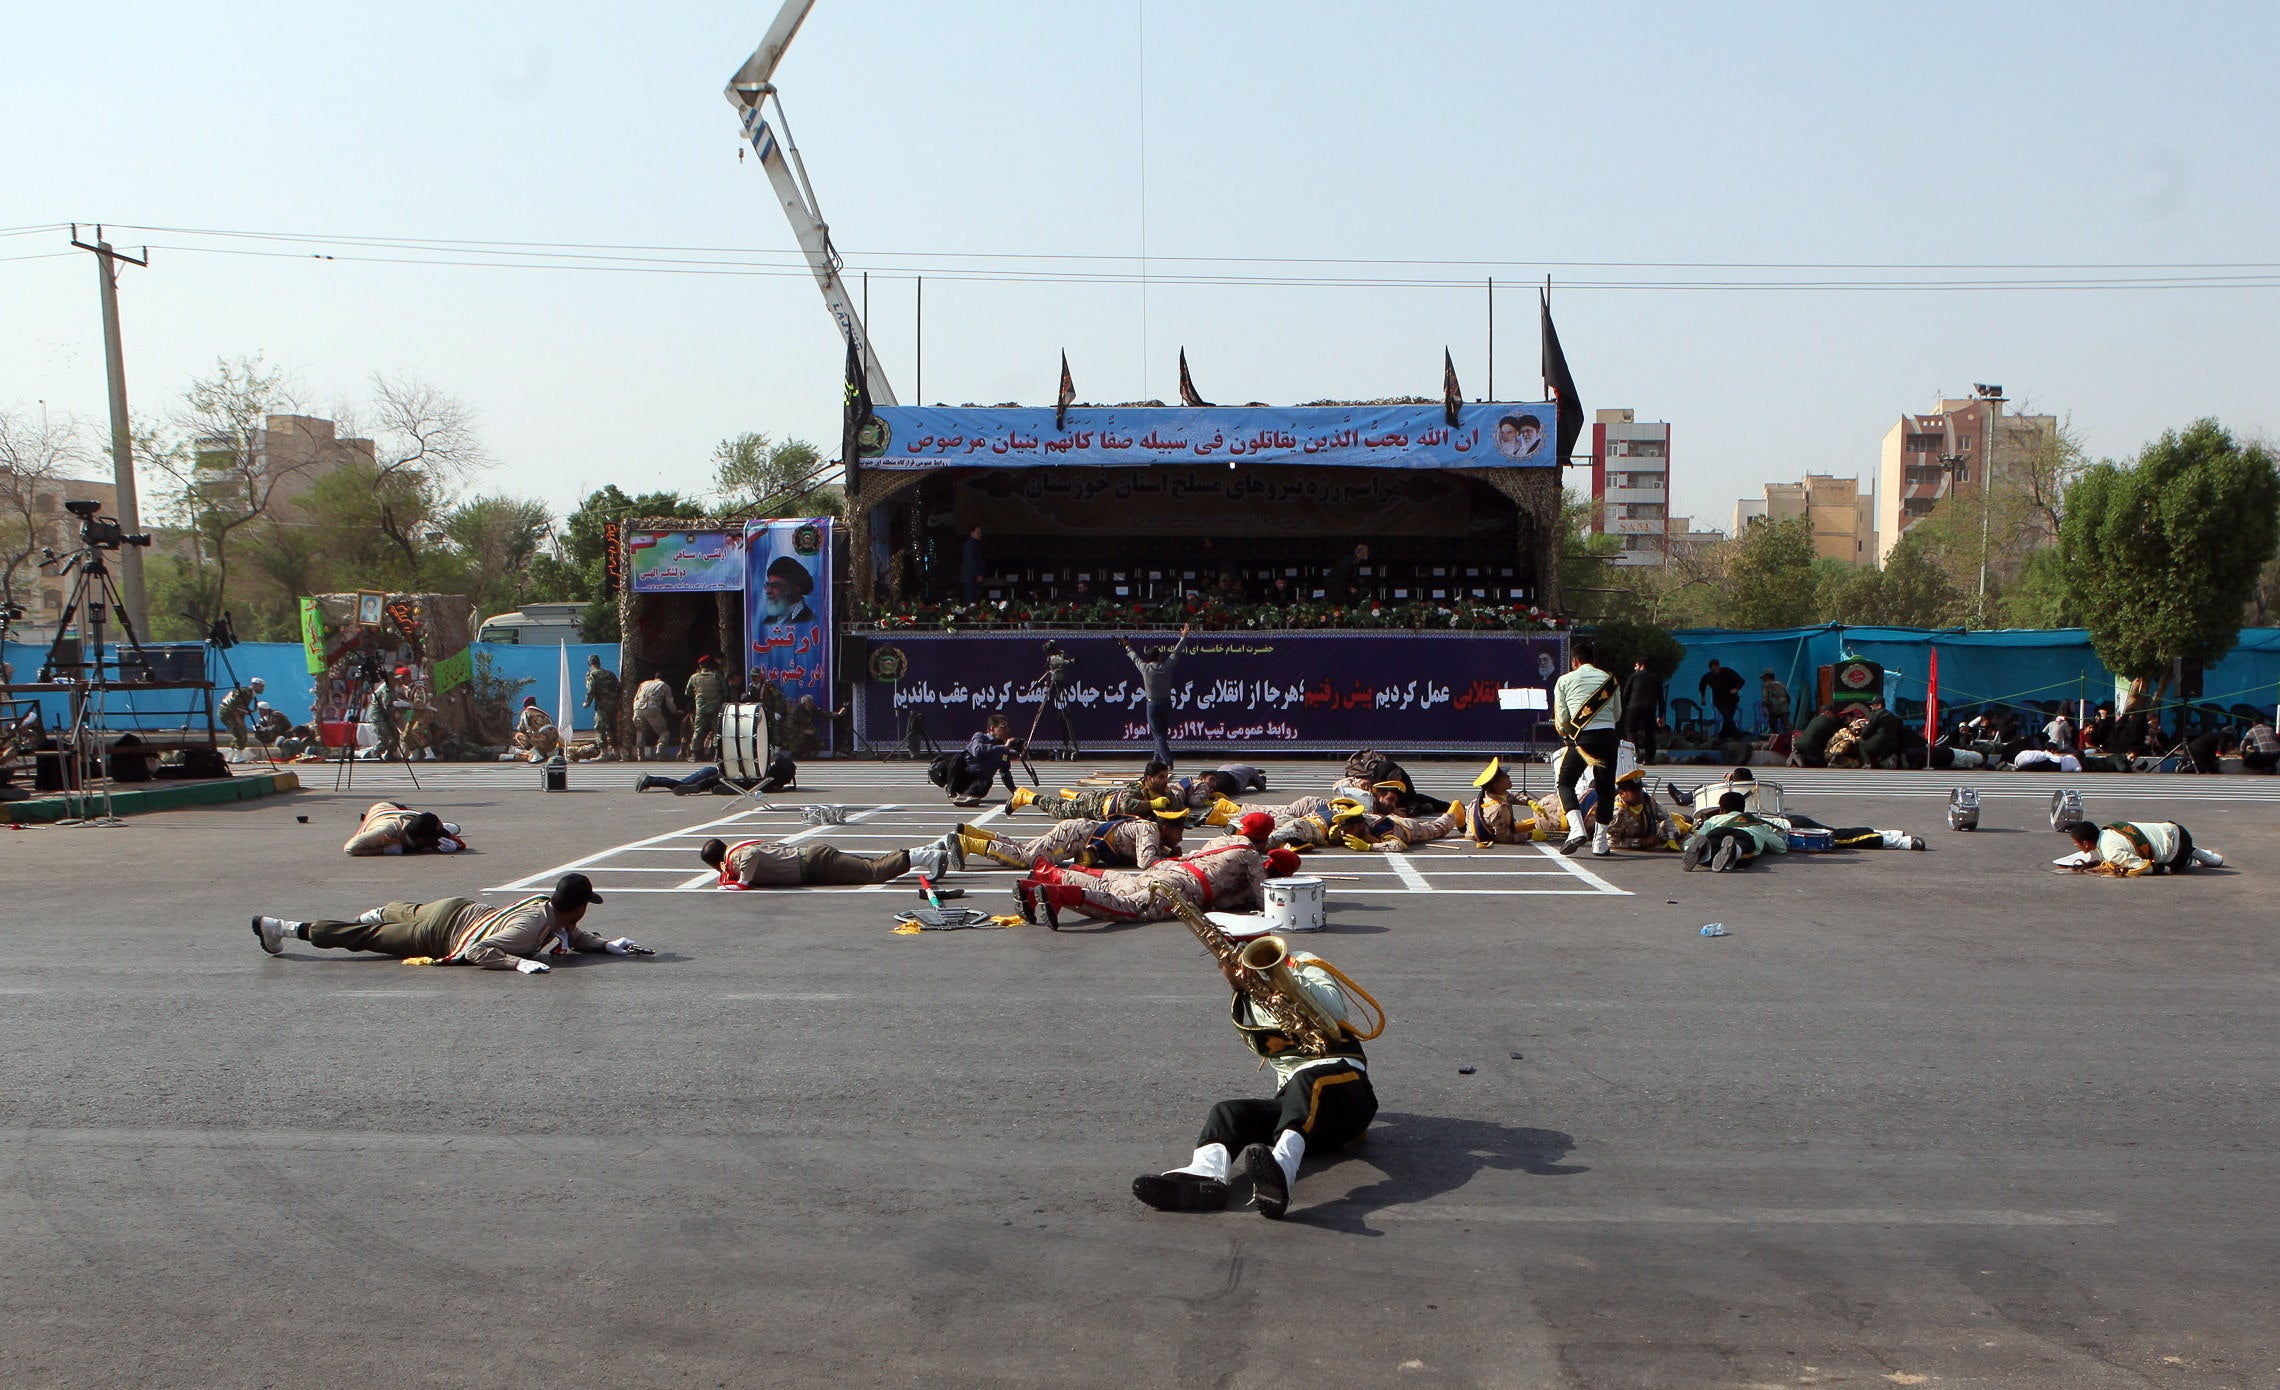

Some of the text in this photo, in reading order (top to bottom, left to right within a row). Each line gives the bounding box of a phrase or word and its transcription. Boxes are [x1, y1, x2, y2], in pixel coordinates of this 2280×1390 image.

[1193, 429, 1223, 456] فی
[1026, 472, 1111, 500] خوزستان
[1114, 473, 1168, 499] استان
[1171, 472, 1222, 499] مسلح
[752, 625, 821, 654] ارتش
[1225, 643, 1245, 655] امام
[1245, 643, 1275, 656] حضرت
[893, 680, 936, 710] ماندیم
[939, 681, 968, 710] عقب
[972, 680, 1012, 711] کردیم
[1197, 679, 1243, 711] انقلابی
[1246, 680, 1262, 710] از
[1343, 680, 1374, 711] پیش
[1375, 680, 1418, 711] کردیم
[1421, 680, 1451, 710] عمل
[1226, 723, 1264, 740] عمومی
[1267, 721, 1298, 740] روابط
